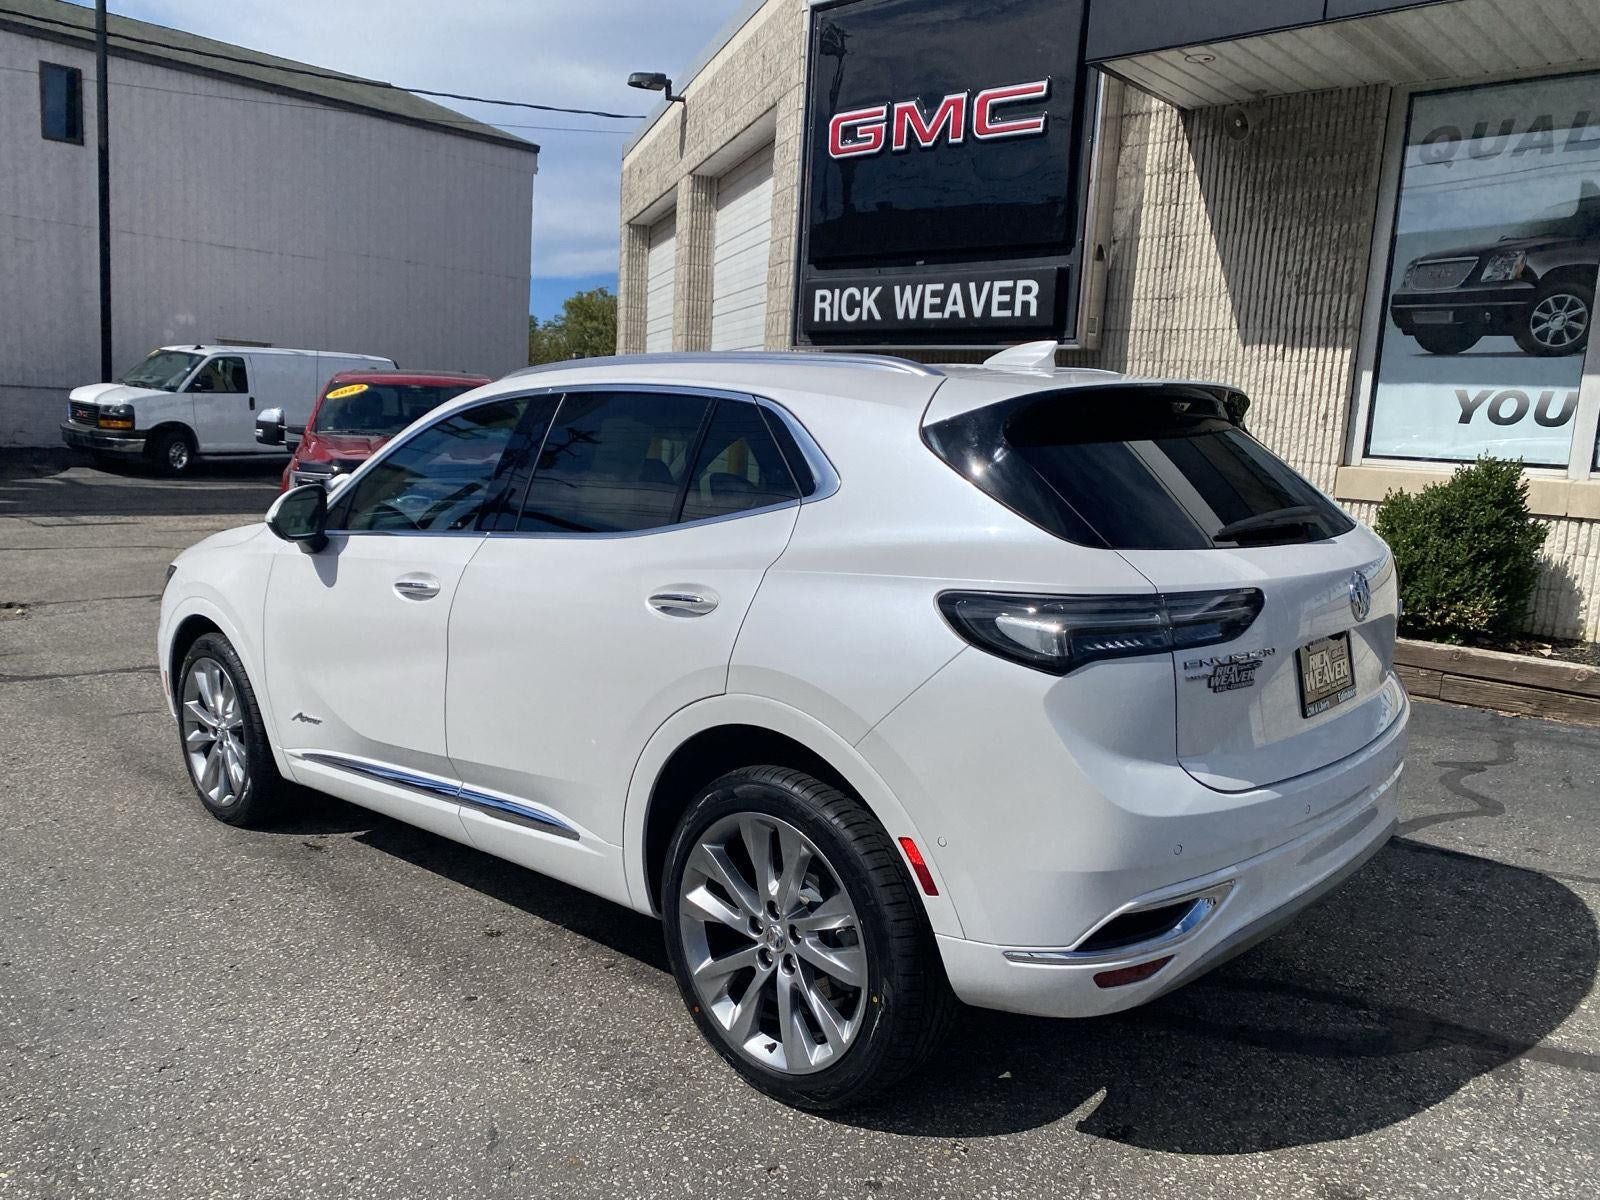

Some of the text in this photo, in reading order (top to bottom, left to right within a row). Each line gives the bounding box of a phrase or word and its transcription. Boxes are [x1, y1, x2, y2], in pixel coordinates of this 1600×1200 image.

[828, 79, 1049, 159] GMC
[813, 279, 1040, 322] RICK WEAVER
[1209, 669, 1256, 687] WEAVER
[1304, 657, 1348, 693] WEAVER
[1308, 649, 1330, 673] RICK
